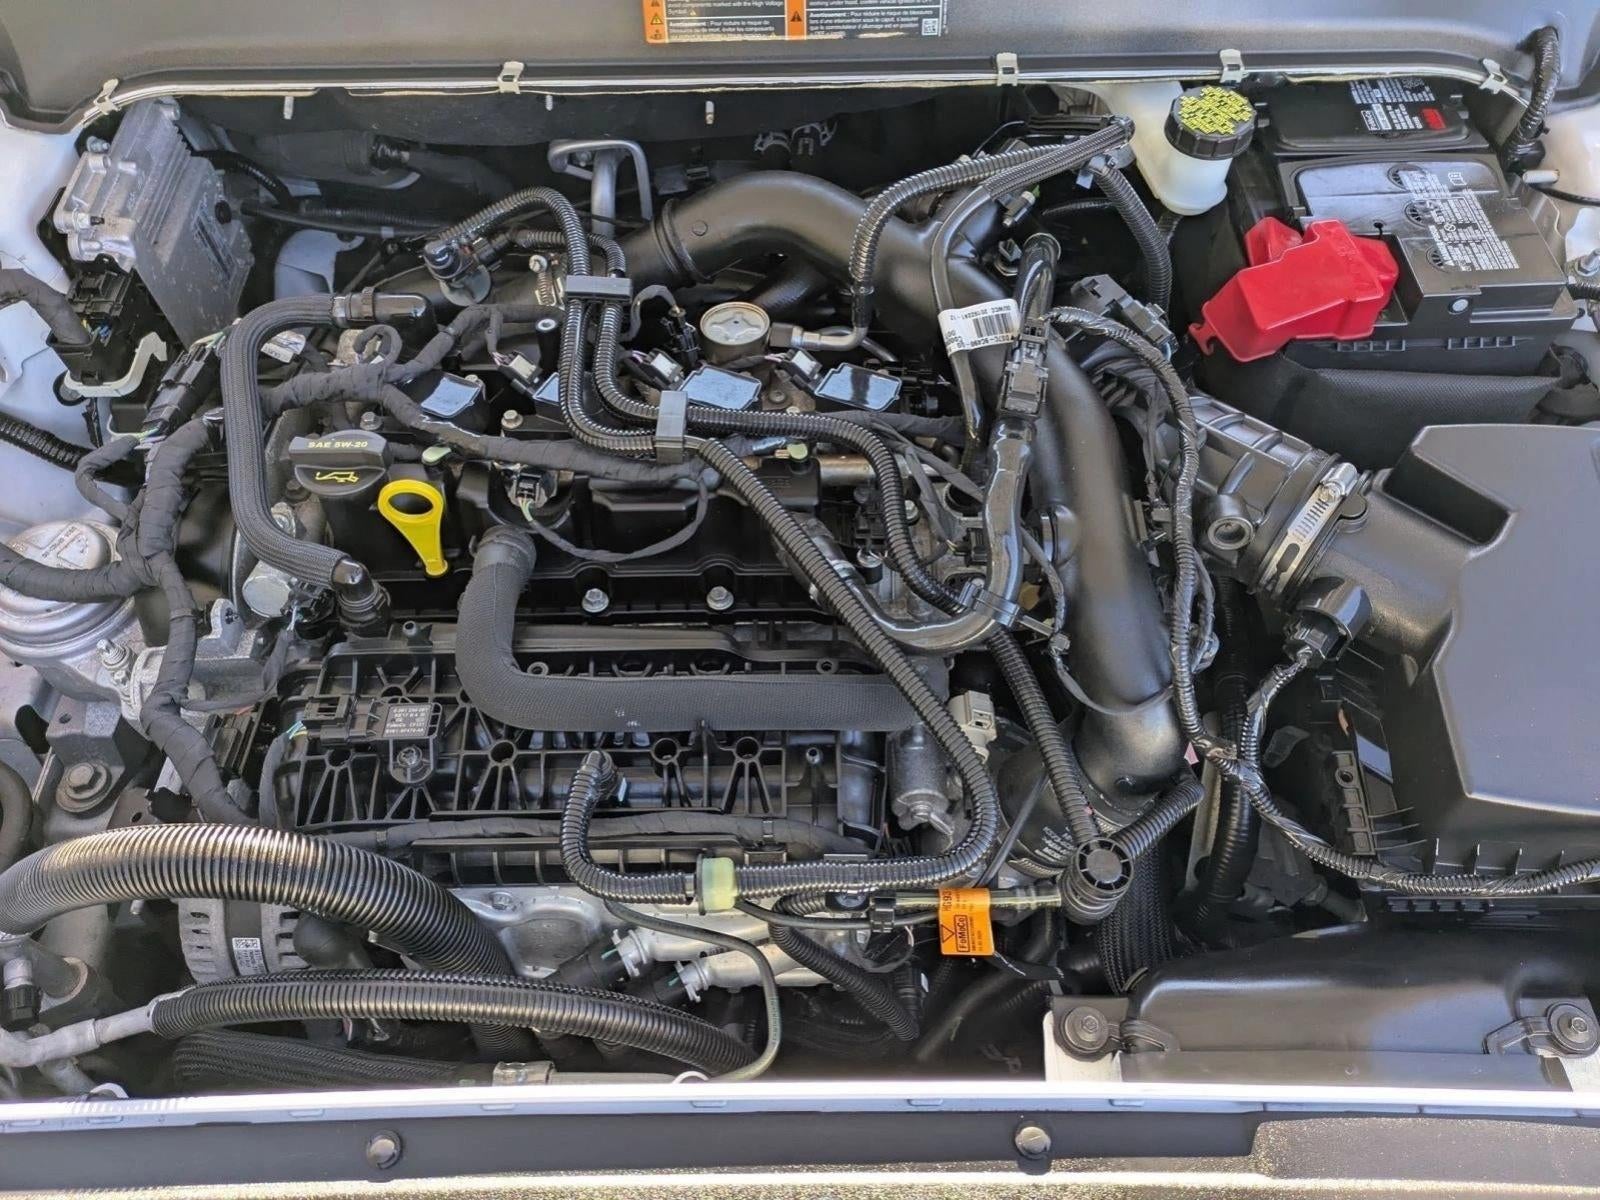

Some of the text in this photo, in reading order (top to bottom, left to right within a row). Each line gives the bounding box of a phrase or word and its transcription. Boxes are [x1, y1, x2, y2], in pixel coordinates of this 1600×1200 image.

[308, 440, 369, 449] SAE 5W-20
[957, 917, 968, 950] FoMoCo
